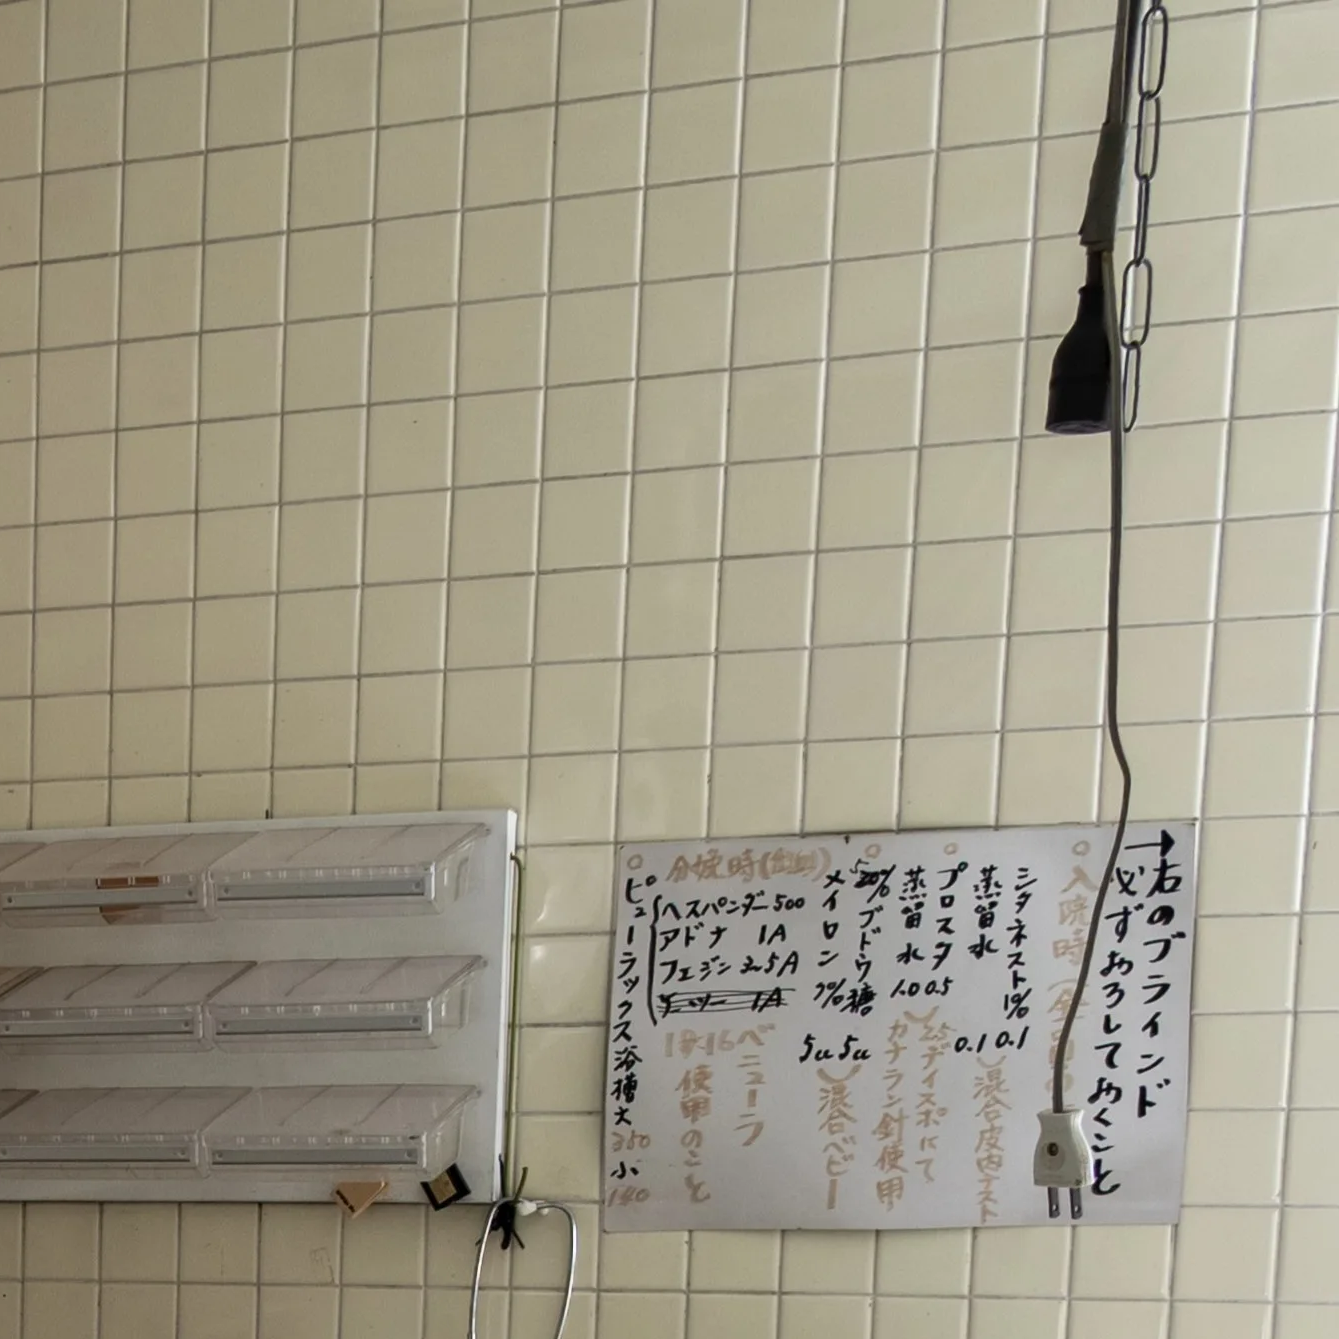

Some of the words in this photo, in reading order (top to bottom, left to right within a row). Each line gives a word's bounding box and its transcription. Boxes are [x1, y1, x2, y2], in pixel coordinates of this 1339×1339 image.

[659, 922, 728, 952] アドナ
[773, 893, 805, 912] 500
[932, 861, 969, 971] プロスタ
[1087, 866, 1145, 1196] 必ずおろしておくこと
[1137, 858, 1186, 1118] 右のブラインド
